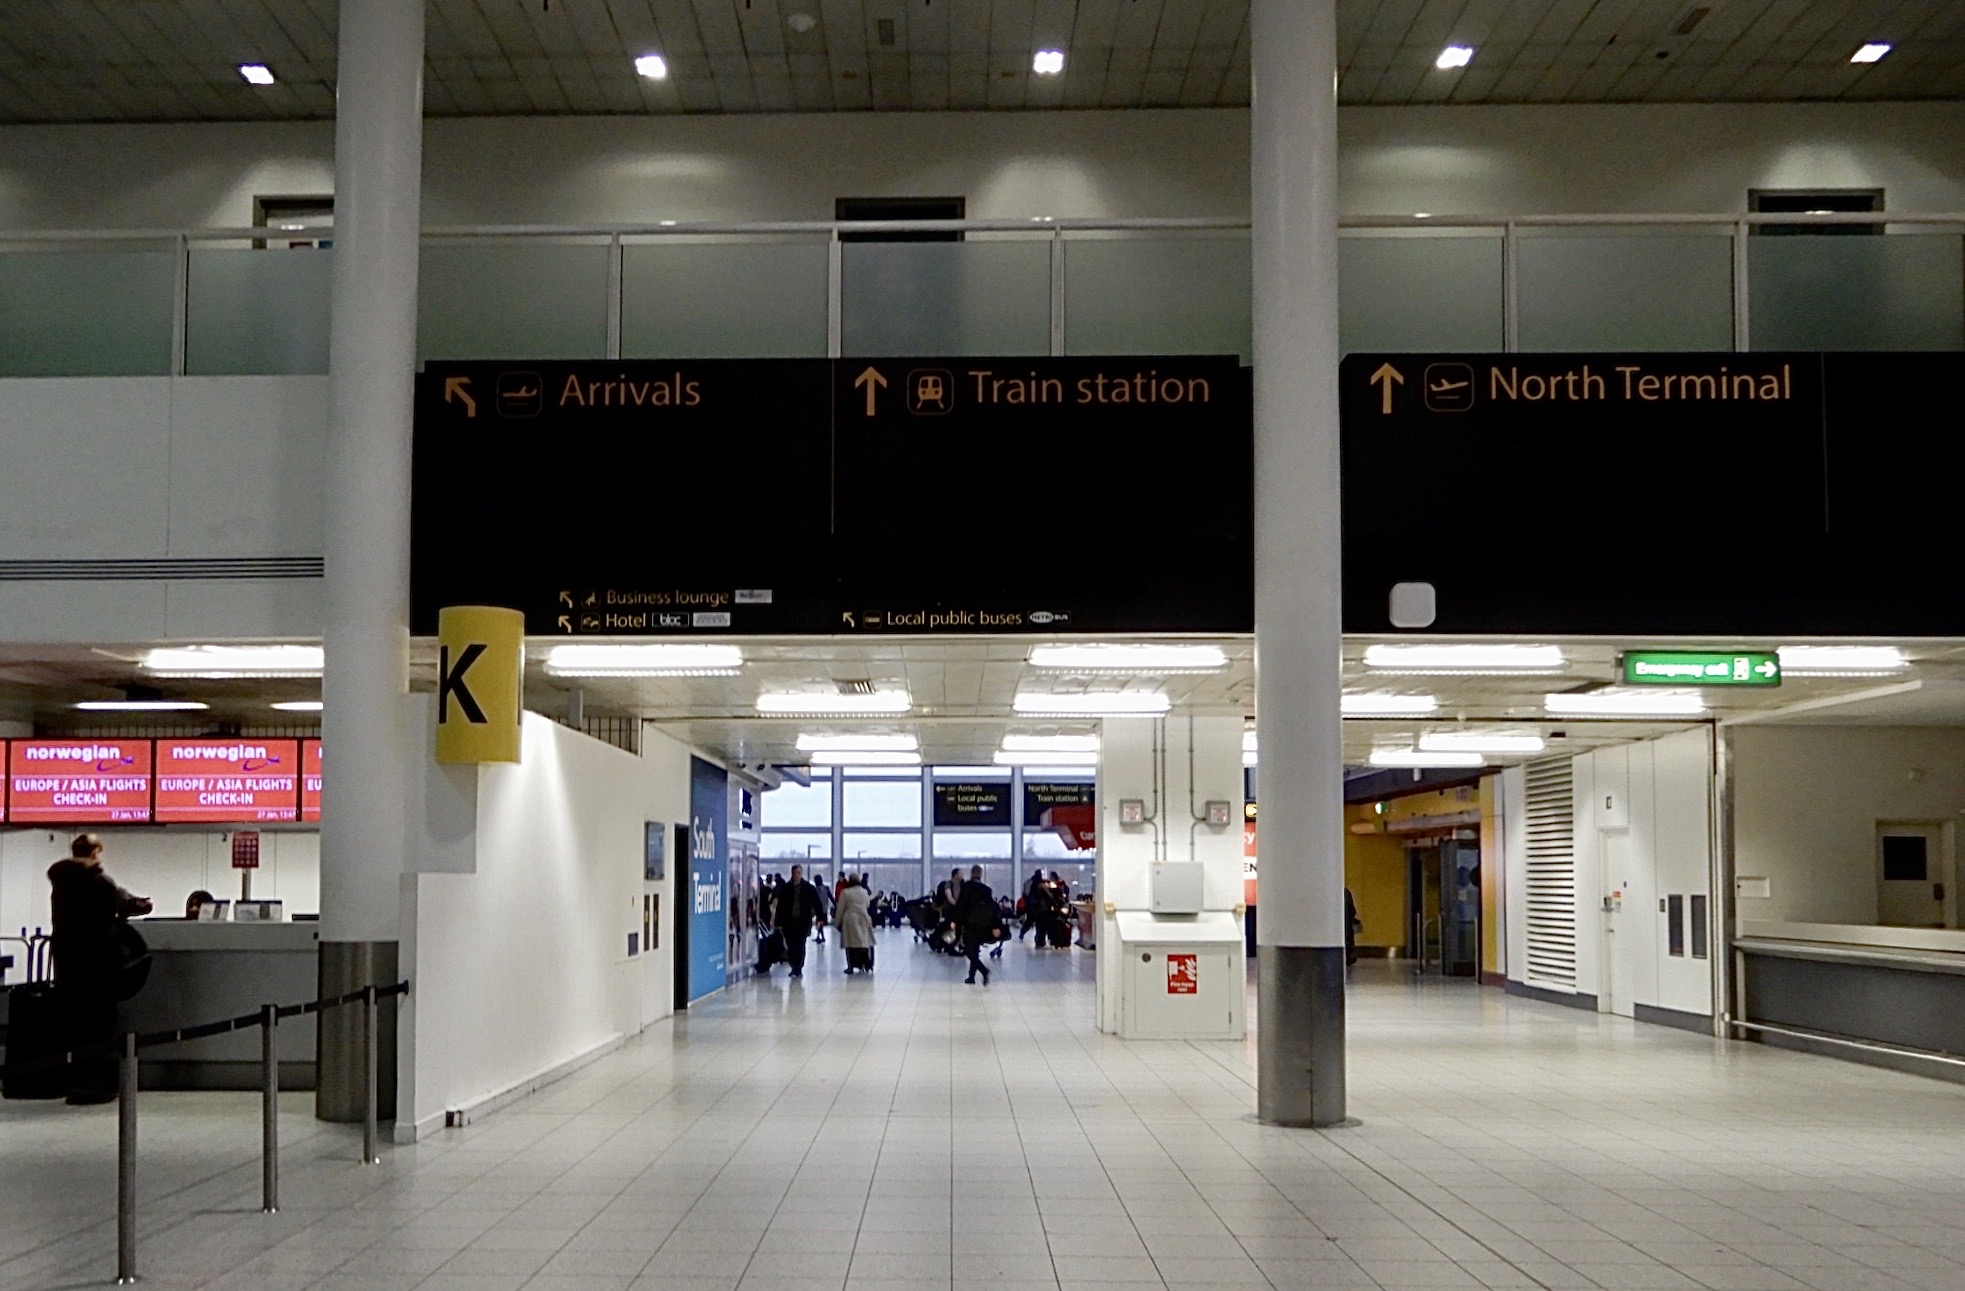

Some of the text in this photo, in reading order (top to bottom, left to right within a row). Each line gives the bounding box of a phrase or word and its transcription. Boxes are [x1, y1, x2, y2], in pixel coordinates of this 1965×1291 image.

[559, 371, 700, 406] Arrivals
[968, 370, 1210, 404] Train station
[1491, 364, 1791, 401] North Terminal
[606, 590, 671, 605] Business
[675, 589, 729, 608] lounge
[606, 612, 646, 628] Hotel
[887, 609, 1022, 628] Local public buses
[1635, 662, 1728, 677] Emergency exit
[438, 644, 488, 725] K
[26, 744, 121, 763] norwegian
[172, 744, 267, 763] norwegian
[15, 779, 59, 792] EUROPE
[70, 779, 97, 792] ASIA
[99, 779, 147, 792] FLIGHTS
[161, 778, 205, 791] EUROPE
[216, 778, 243, 791] ASIA
[245, 778, 293, 791] FLIGHTS
[957, 784, 983, 793] Arrivals
[1028, 784, 1079, 793] North Terminal
[53, 792, 108, 806] CHECK-IN
[199, 792, 254, 805] CHECK-IN
[957, 794, 998, 804] Local public
[1037, 794, 1079, 803] Train station
[957, 804, 977, 812] buses
[694, 815, 715, 860] South
[693, 870, 722, 915] Terminal
